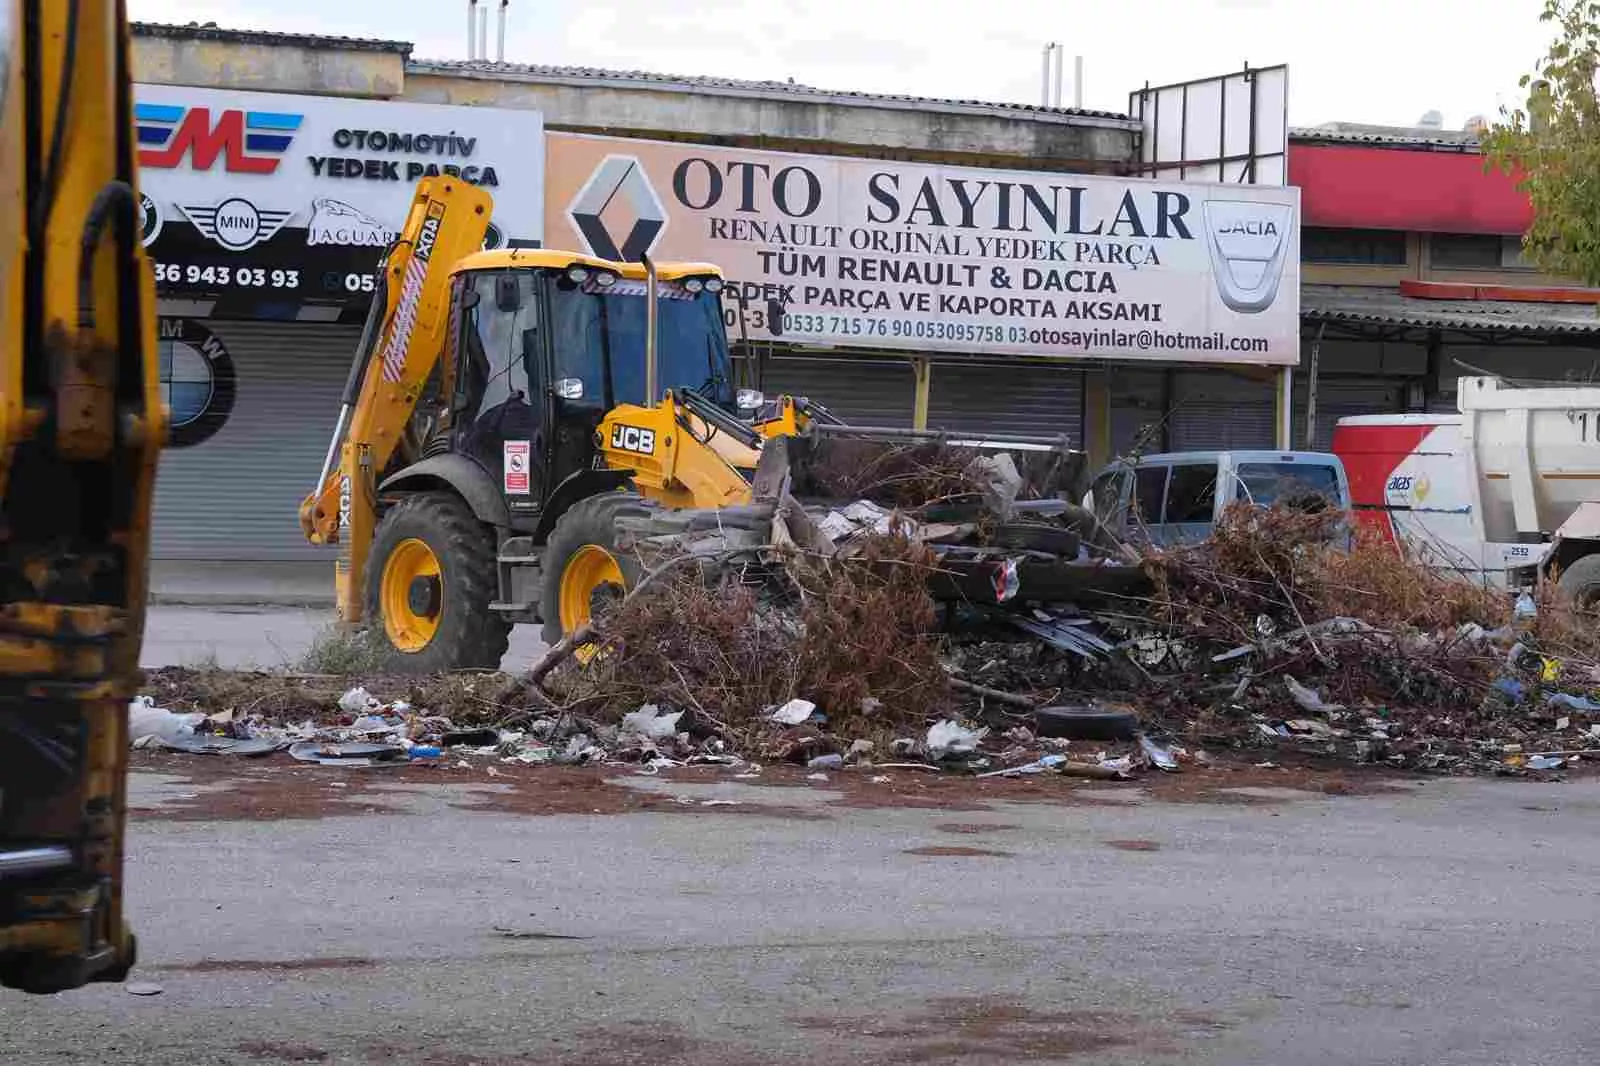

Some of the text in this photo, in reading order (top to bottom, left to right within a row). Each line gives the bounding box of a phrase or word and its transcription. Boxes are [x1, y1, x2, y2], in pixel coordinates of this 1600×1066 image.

[333, 128, 477, 157] OTOMOTİV
[307, 156, 400, 181] YEDEK
[672, 158, 1195, 240] OTO SAYINLAR
[219, 215, 254, 230] MINI
[310, 229, 394, 243] JAGUAR
[709, 216, 1161, 270] RENAULT ORJİNAL YEDEK PARÇA
[186, 265, 230, 285] 943
[236, 268, 266, 287] 03
[271, 270, 300, 289] 93
[344, 273, 377, 291] 05
[757, 246, 1118, 294] TÜM RENAULT & DACIA
[726, 280, 1162, 323] EDEK PARÇA VE KAPORTA AKSAMI
[783, 313, 824, 333] 0533
[830, 317, 861, 335] 715
[867, 318, 887, 337] 76
[612, 425, 654, 454] JCB
